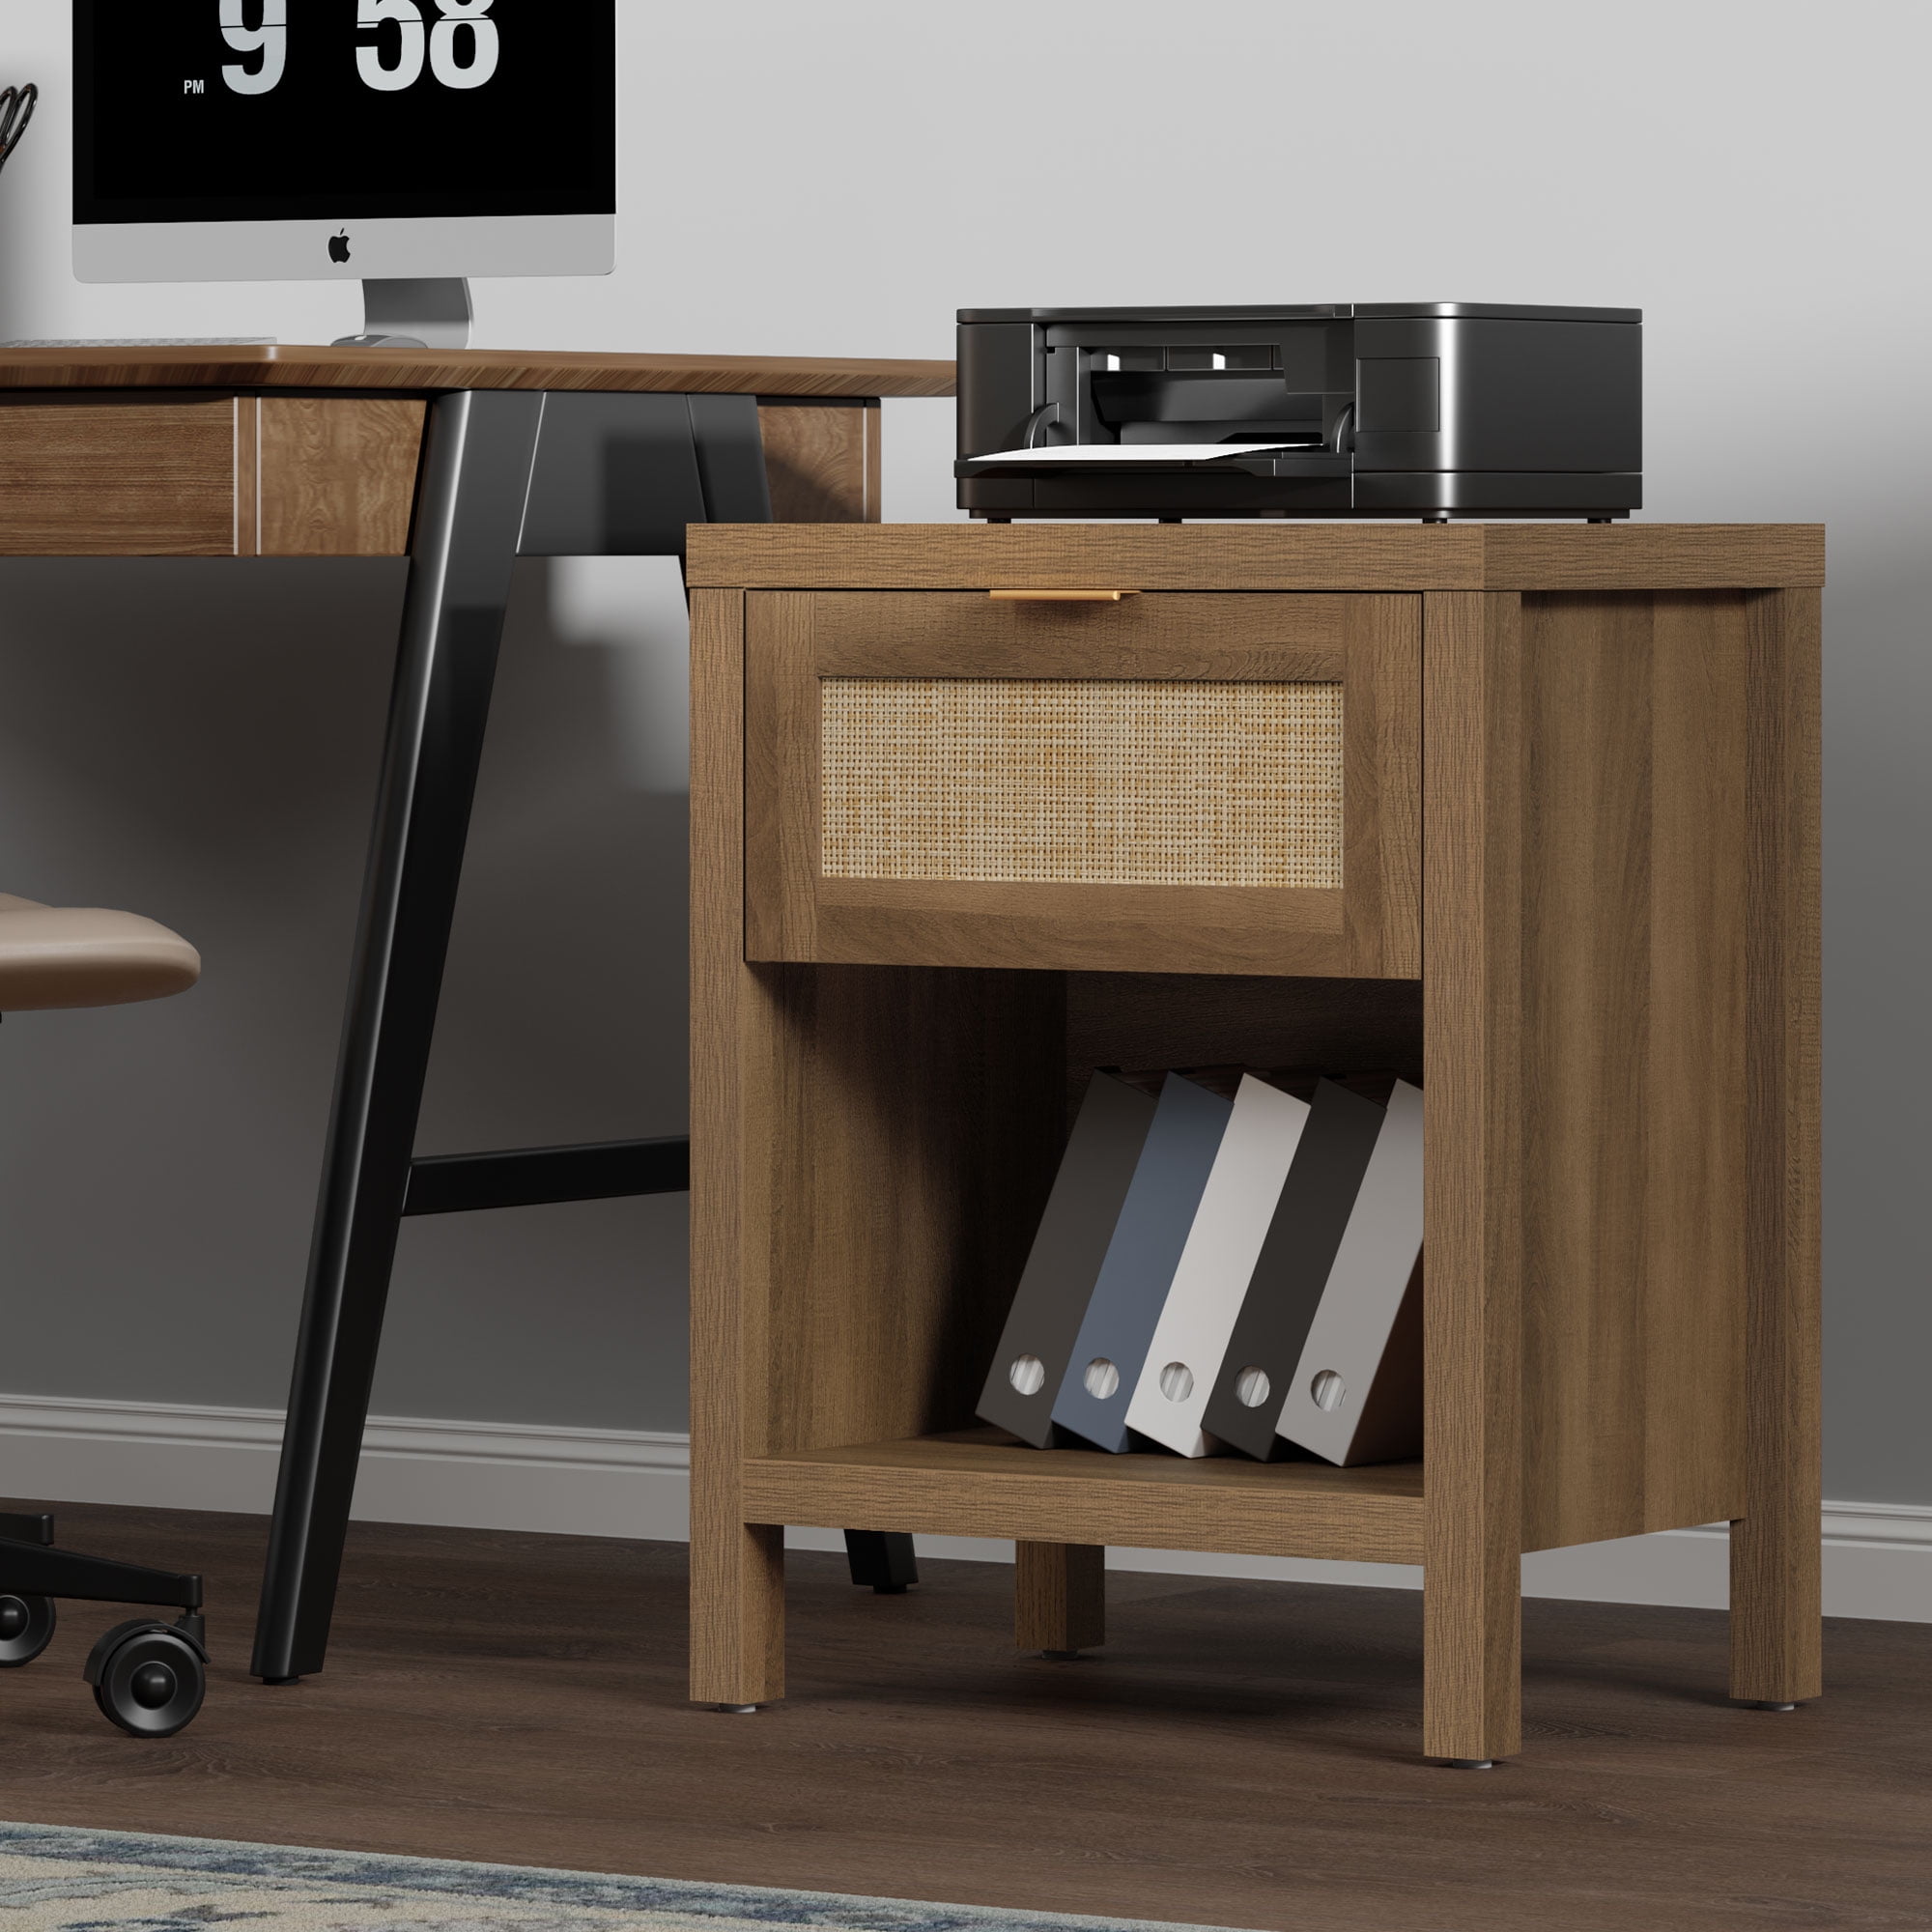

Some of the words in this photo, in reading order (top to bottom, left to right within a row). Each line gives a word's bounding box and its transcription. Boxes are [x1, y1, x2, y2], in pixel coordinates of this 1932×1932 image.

[219, 0, 287, 95] 9
[355, 0, 499, 91] 58
[184, 79, 205, 95] PM
